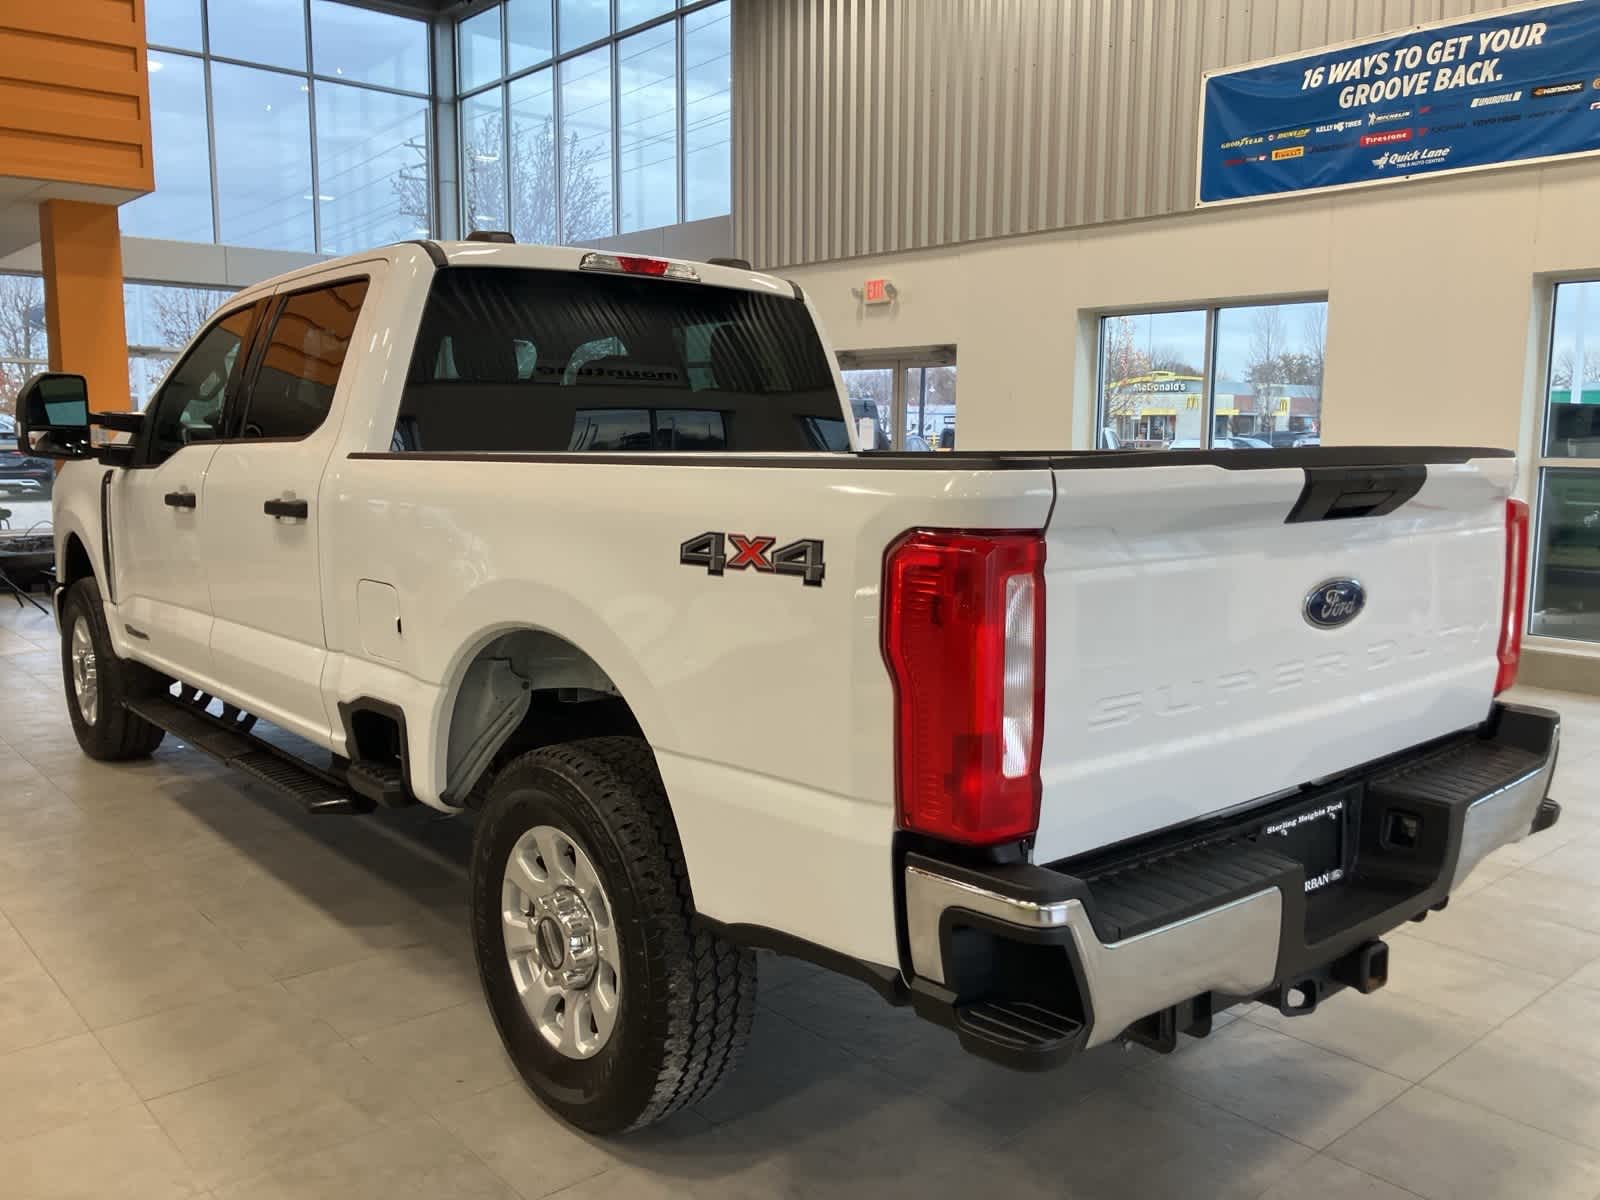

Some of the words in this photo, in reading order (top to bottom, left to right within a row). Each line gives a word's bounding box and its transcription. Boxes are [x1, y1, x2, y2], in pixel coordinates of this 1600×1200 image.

[1301, 66, 1325, 90] 16
[1327, 52, 1390, 85] WAYS
[1393, 45, 1422, 73] TO
[1426, 34, 1473, 65] GET
[1477, 22, 1547, 55] YOUR
[1338, 70, 1431, 109] GROOVE
[1433, 58, 1504, 92] BACK.
[1221, 137, 1264, 149] GOODYEAR
[1277, 128, 1311, 140] DUNLOP
[1365, 132, 1408, 145] Firestone
[1389, 149, 1420, 164] Quick
[1420, 147, 1450, 159] Lane
[866, 280, 884, 300] EXIT
[1133, 381, 1186, 392] McDonald's
[1088, 650, 1350, 733] SUPER
[1266, 819, 1297, 834] Sterling
[1298, 809, 1325, 823] Heights
[1327, 801, 1342, 813] Ford
[1304, 873, 1329, 892] RBAN
